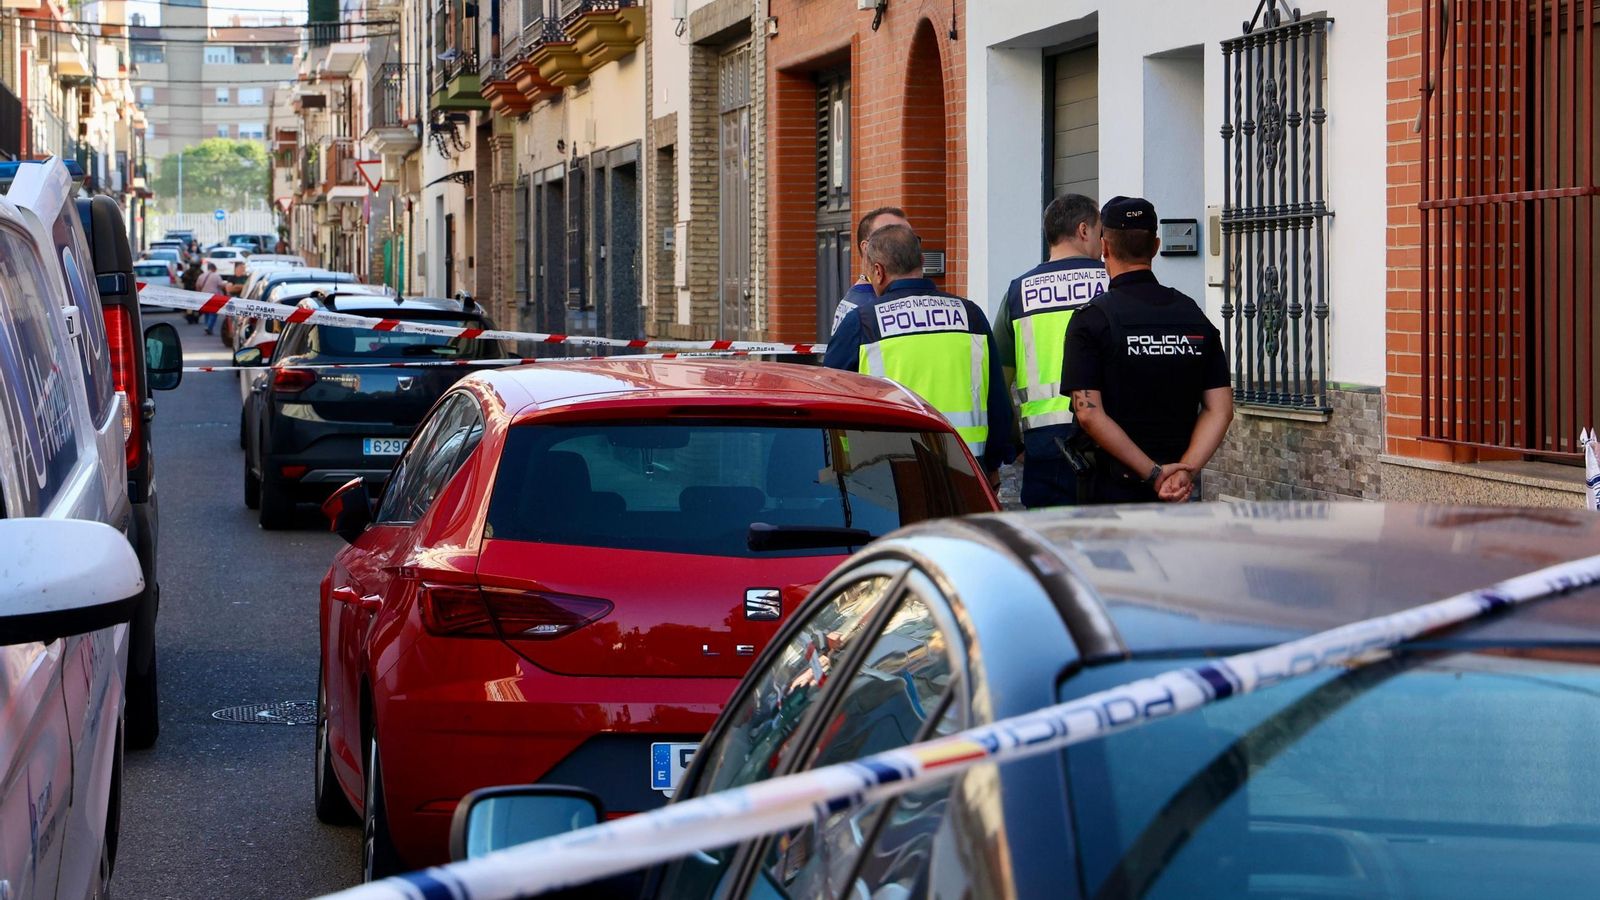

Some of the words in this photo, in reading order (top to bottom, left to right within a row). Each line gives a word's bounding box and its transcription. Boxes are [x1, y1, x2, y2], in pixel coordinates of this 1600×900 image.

[1126, 210, 1143, 218] CNP
[1024, 274, 1056, 288] CUERPO
[1056, 271, 1094, 282] NACIONAL
[1095, 270, 1106, 279] DE
[1024, 281, 1105, 307] POLICIA
[878, 300, 912, 314] CUERPO
[912, 298, 949, 309] NACIONAL
[950, 299, 961, 308] DE
[881, 309, 965, 333] POLICIA
[1126, 335, 1190, 345] POLICIA
[1127, 345, 1202, 356] NACIONAL
